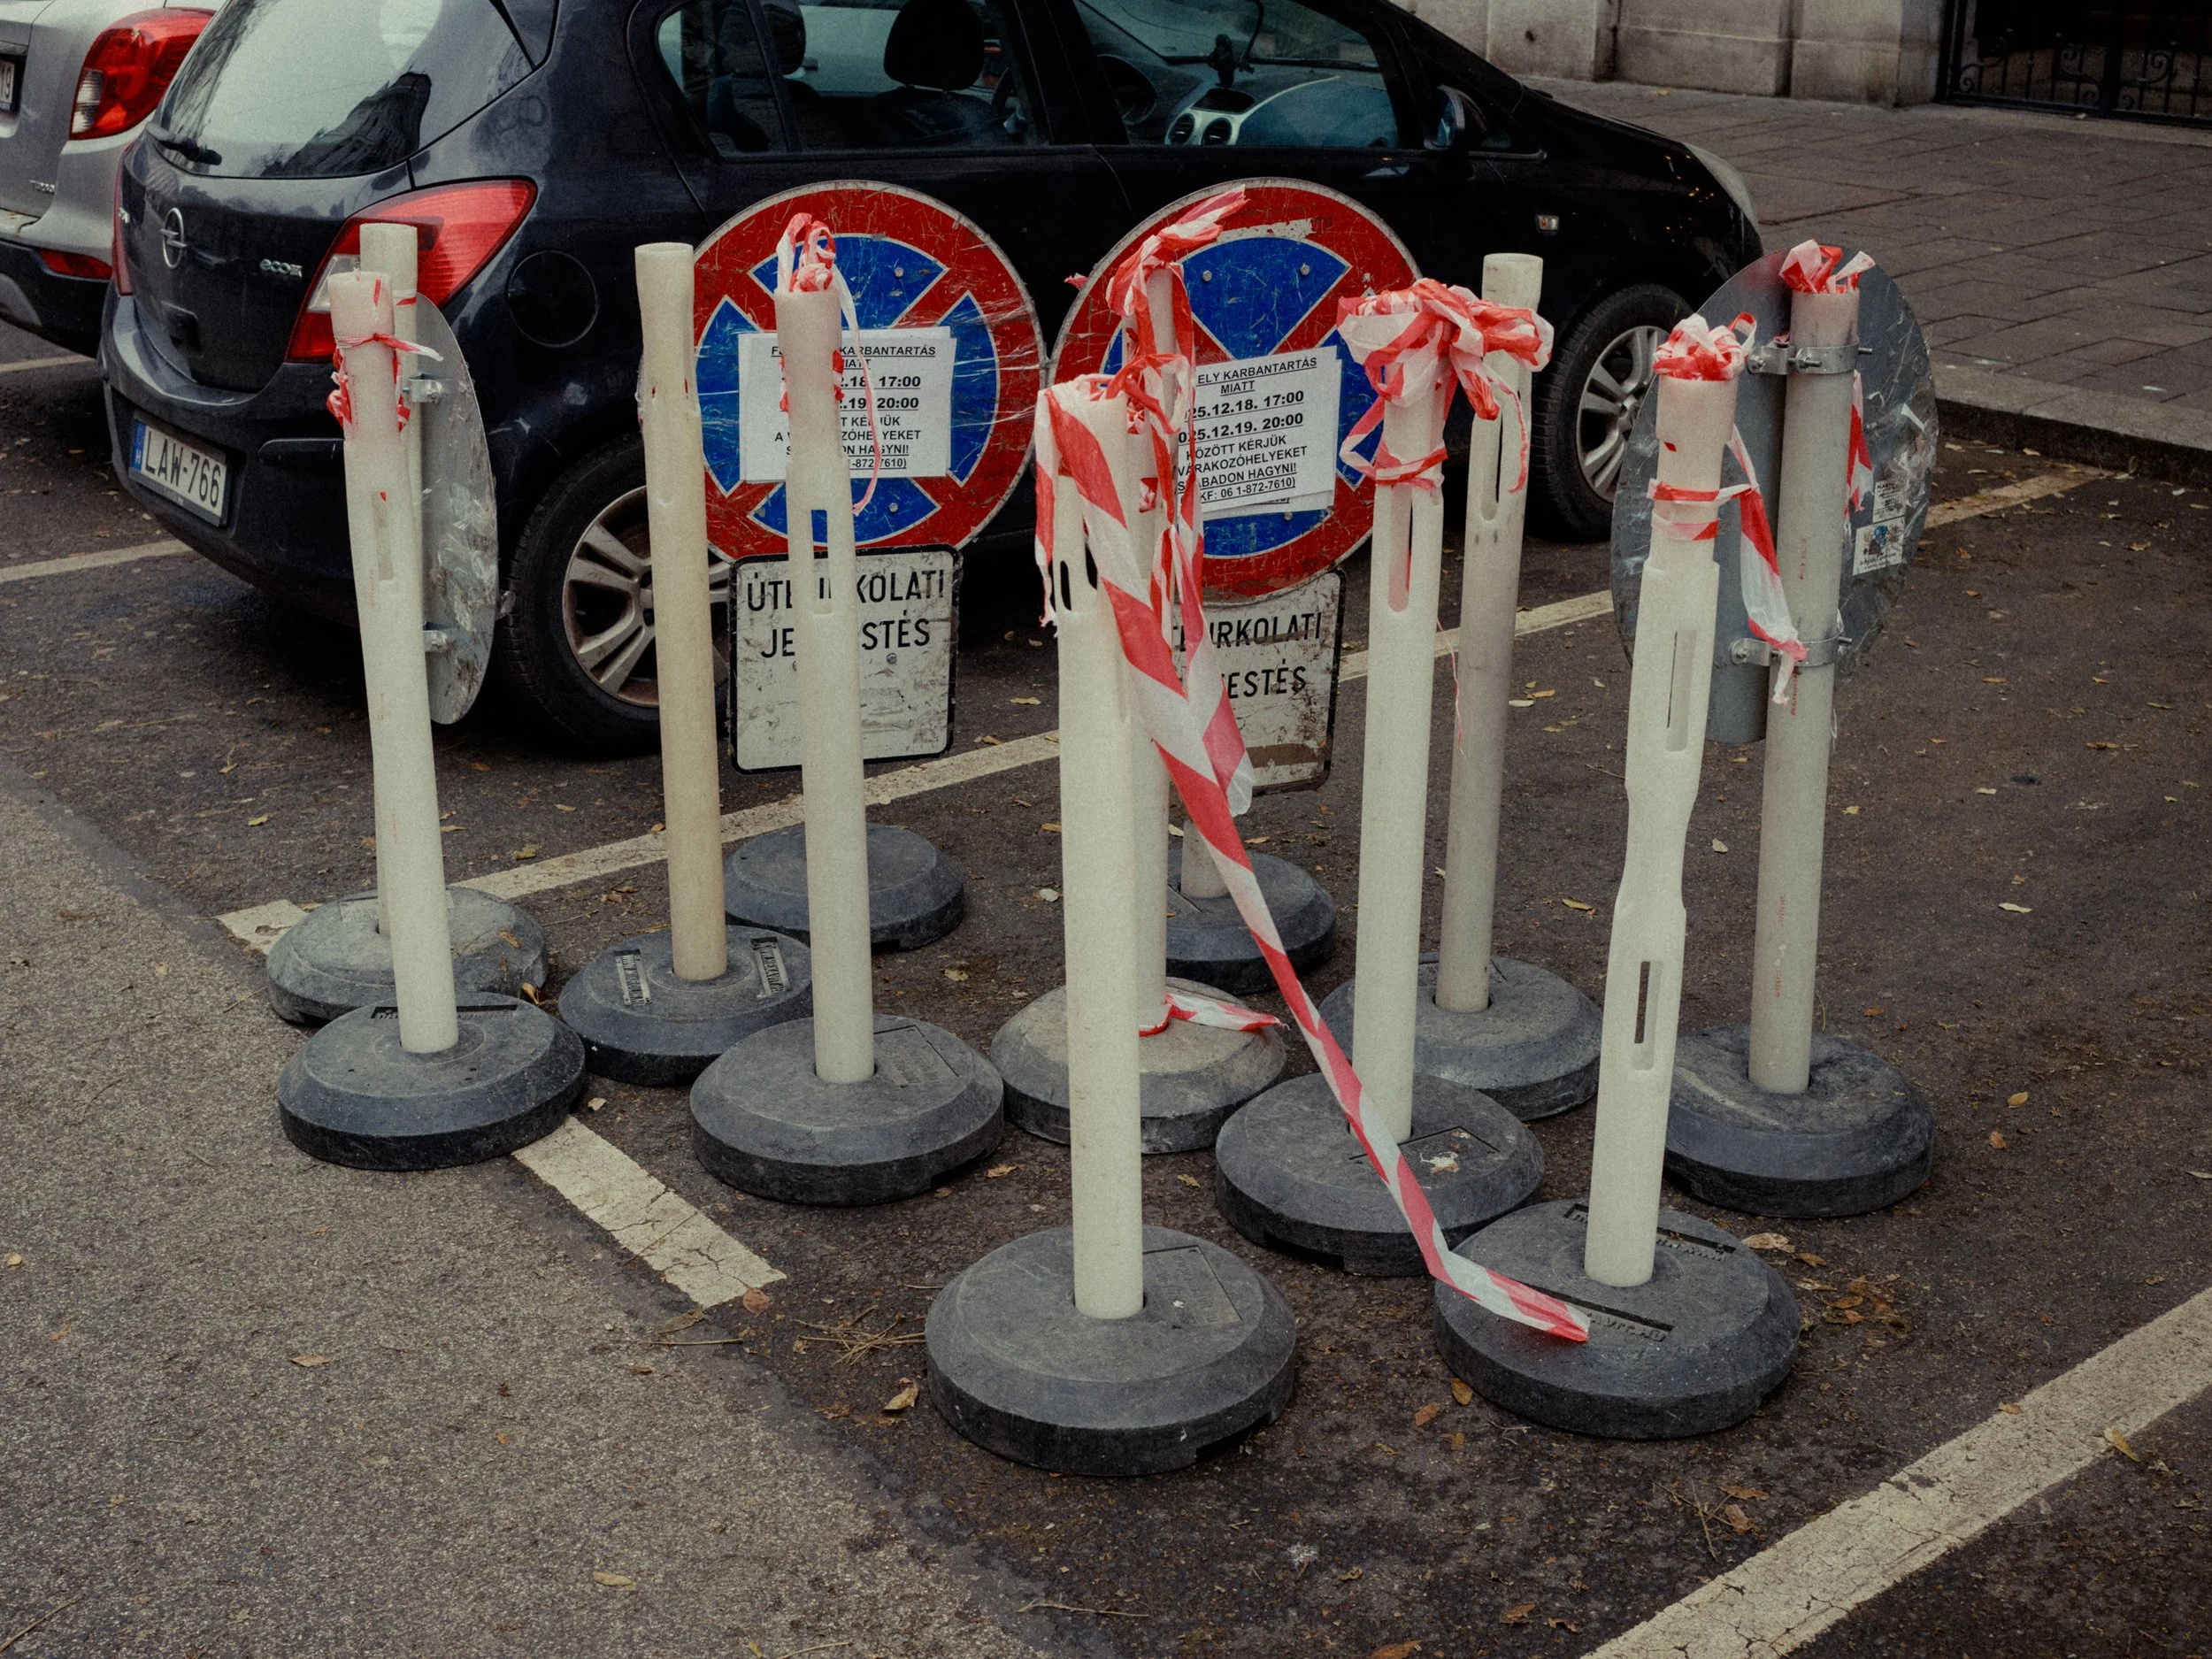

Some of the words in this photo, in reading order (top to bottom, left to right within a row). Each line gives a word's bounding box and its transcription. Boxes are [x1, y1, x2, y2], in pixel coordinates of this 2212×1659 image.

[844, 359, 872, 368] IATT
[1224, 357, 1317, 380] KARBANTARTÁS
[879, 376, 921, 388] 17:00
[1221, 380, 1256, 395] MIATT
[877, 397, 919, 409] 20:00
[1263, 390, 1304, 408] 17:00
[851, 414, 901, 426] KÉÜK
[1263, 413, 1303, 430] 20:00
[774, 432, 784, 442] A
[1239, 434, 1286, 452] KÉRJÜK
[145, 431, 221, 508] LAW-766
[1178, 471, 1244, 491] SBADON
[1248, 463, 1297, 479] HAGYNI!
[1221, 488, 1233, 498] 06
[1238, 477, 1296, 495] 1-872-7610)
[748, 570, 944, 611] ÚTKOLATI
[761, 611, 930, 657] JESTÉS
[1221, 658, 1307, 699] ESTÉS
